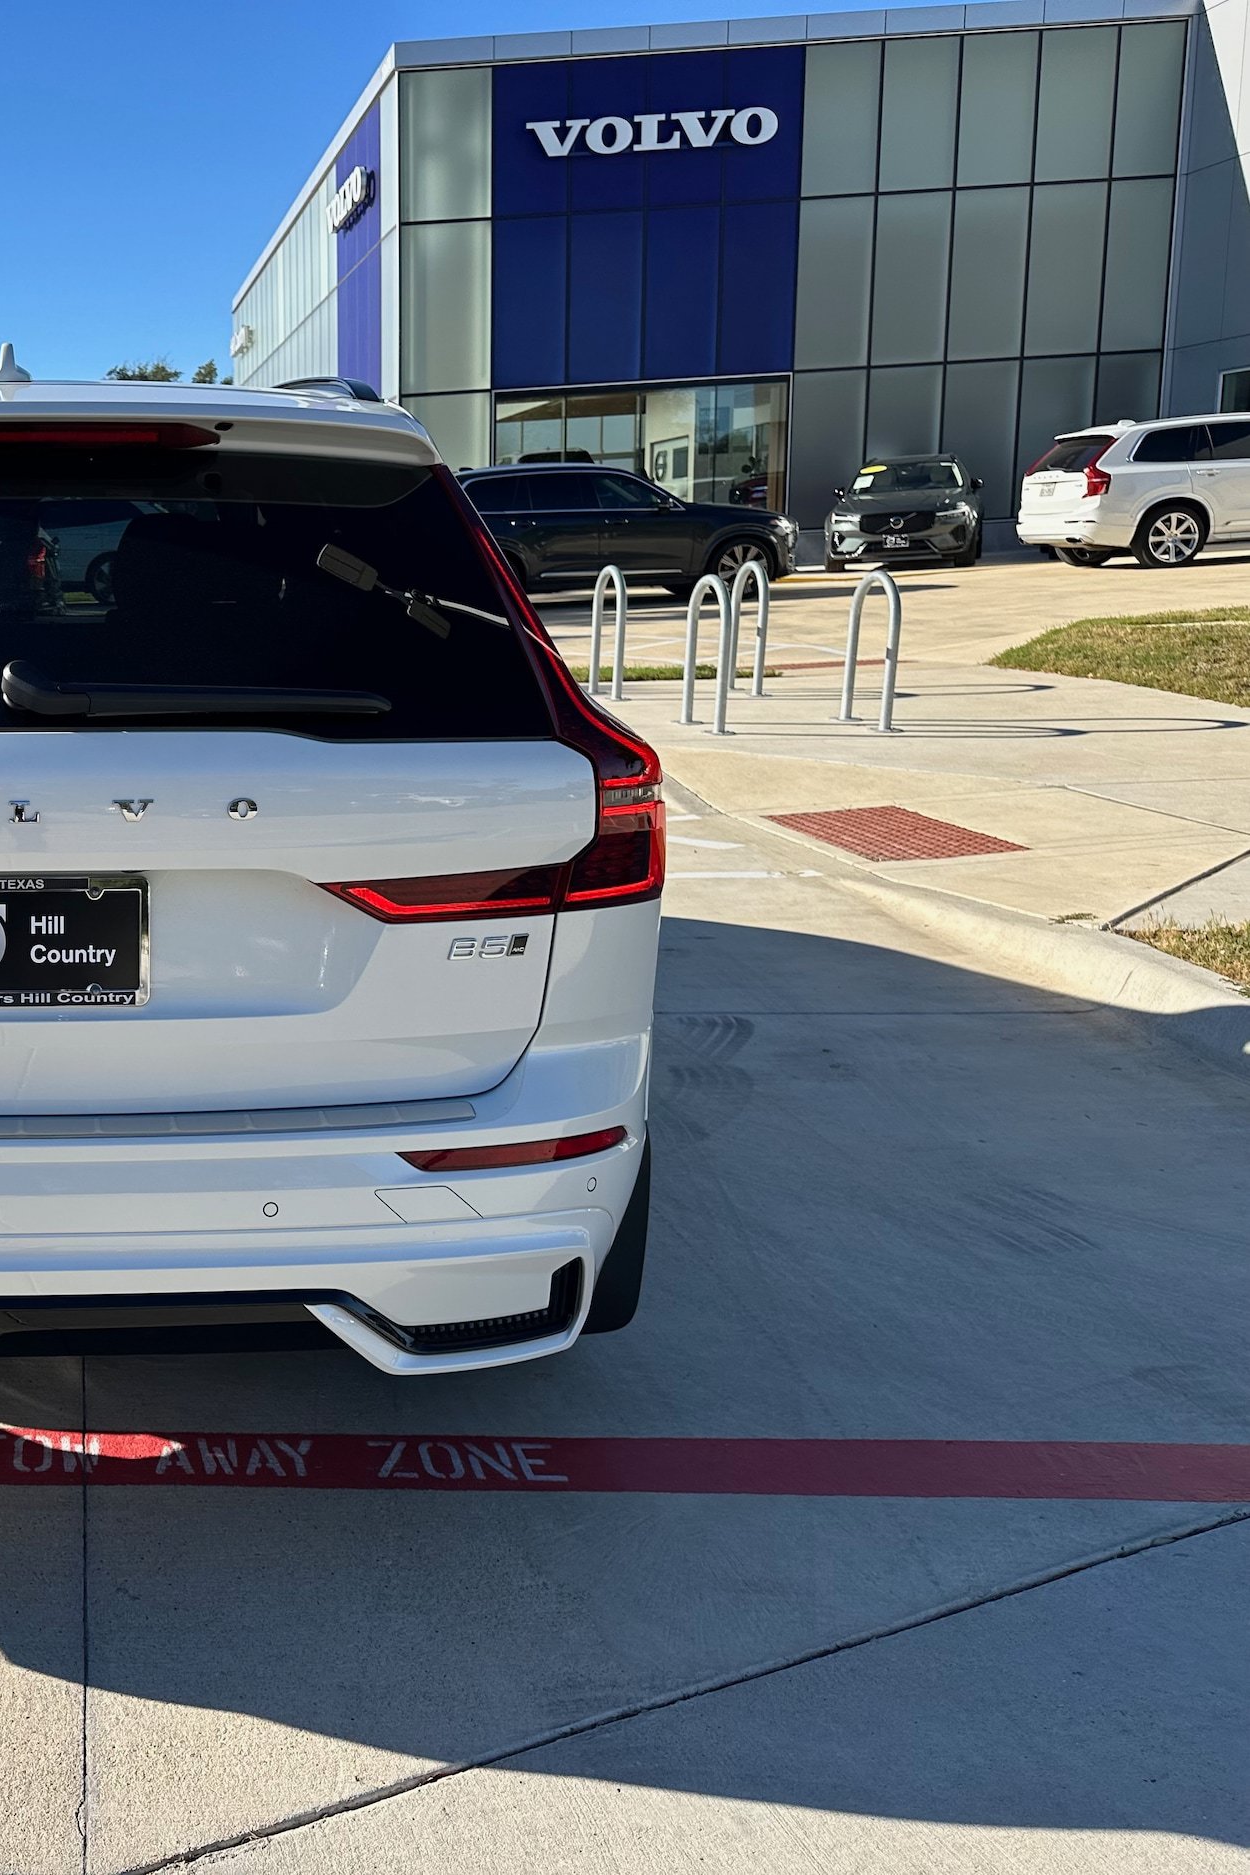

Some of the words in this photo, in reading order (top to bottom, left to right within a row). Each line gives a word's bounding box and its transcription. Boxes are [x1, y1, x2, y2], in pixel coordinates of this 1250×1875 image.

[526, 106, 779, 158] VOLVO
[326, 166, 366, 234] VOLVO
[30, 915, 65, 935] Hill
[30, 944, 116, 966] Country
[447, 935, 508, 961] B5
[20, 992, 51, 1004] Hill
[56, 992, 135, 1005] Country
[156, 1438, 312, 1478] AWAY
[368, 1440, 569, 1483] ZONE
